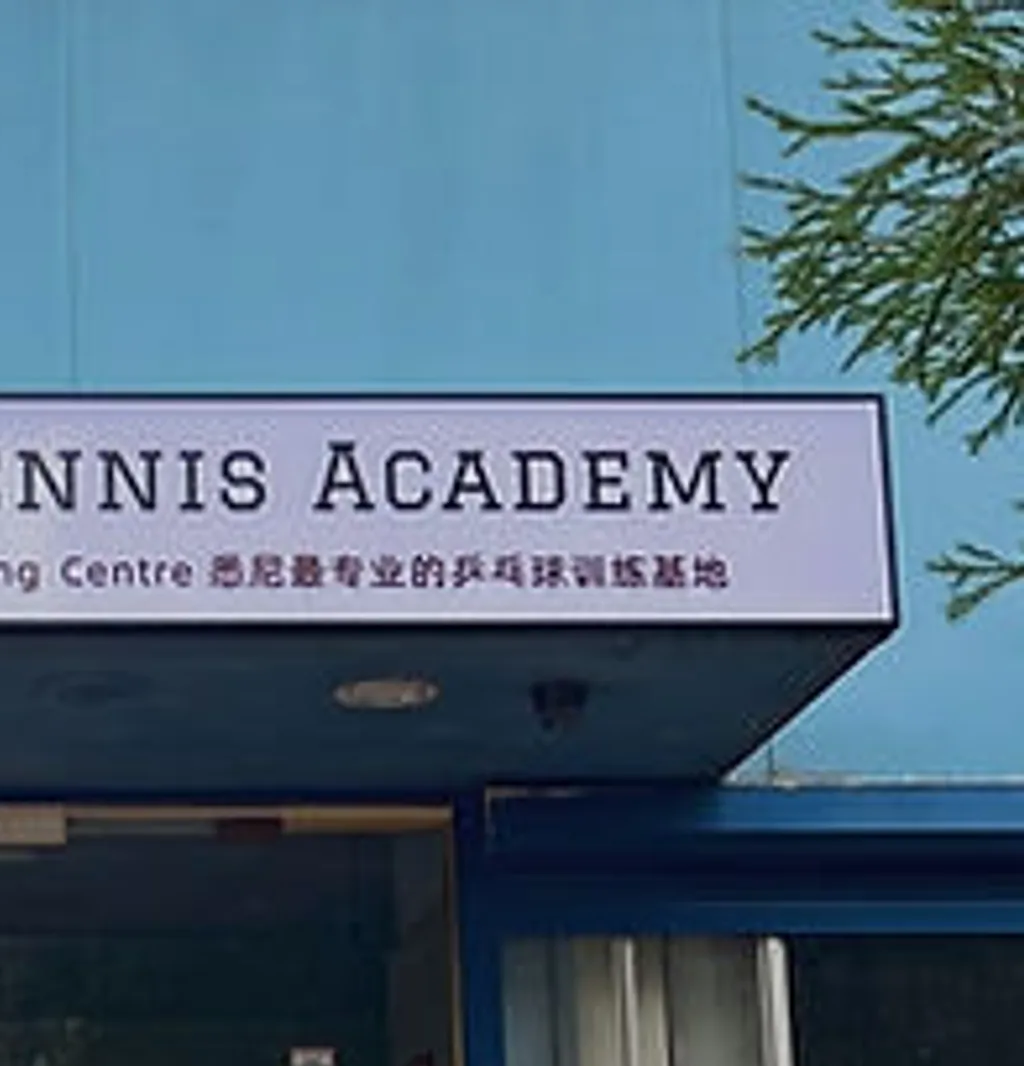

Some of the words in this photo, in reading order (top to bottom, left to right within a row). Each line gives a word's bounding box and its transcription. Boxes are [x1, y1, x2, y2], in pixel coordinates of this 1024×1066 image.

[312, 439, 790, 514] ACADEMY
[59, 555, 193, 589] Centre
[207, 551, 731, 591] 悉尼最专业的乒乓球训练基地
